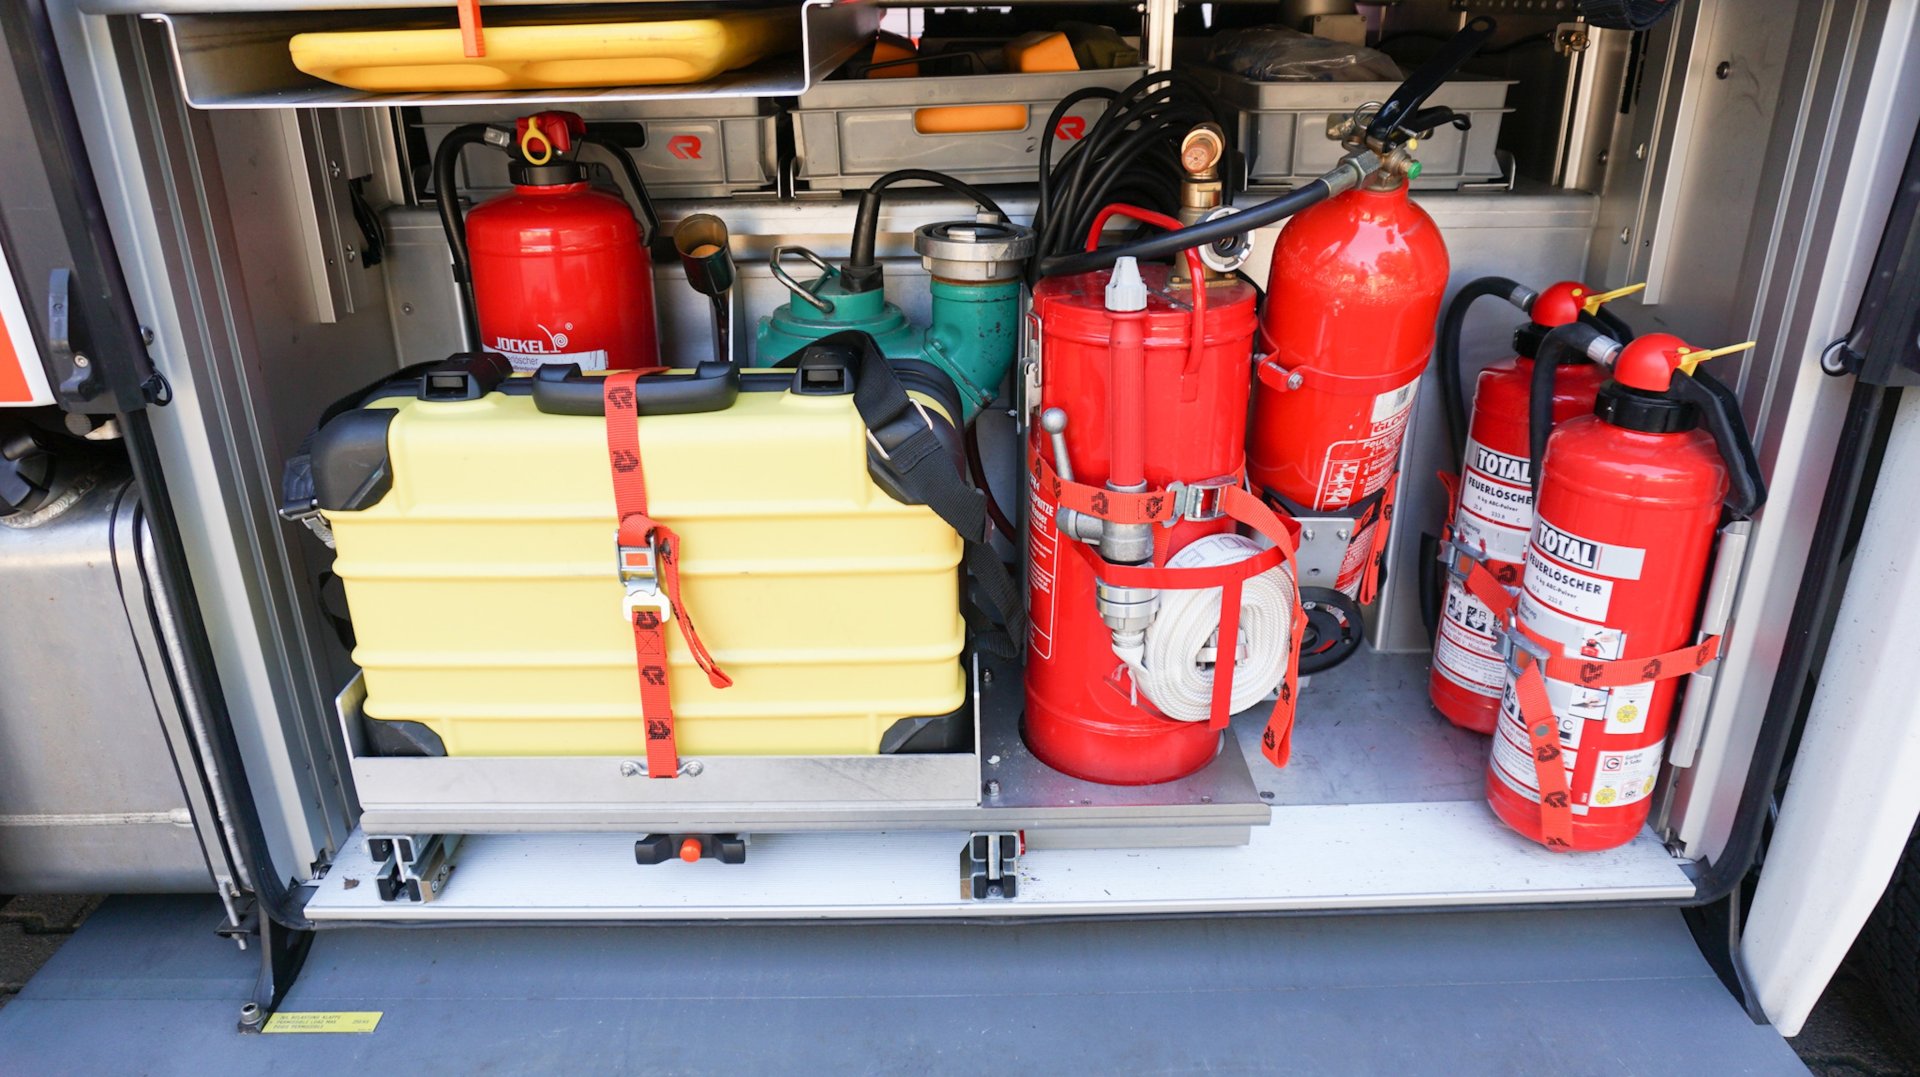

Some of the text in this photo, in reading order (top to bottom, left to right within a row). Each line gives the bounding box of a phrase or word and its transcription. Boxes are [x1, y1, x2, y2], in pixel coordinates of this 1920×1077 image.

[495, 336, 549, 354] JOCKEL
[1478, 449, 1532, 484] TOTAL
[1467, 476, 1533, 506] FEUERLÖSCHE
[1538, 522, 1594, 568] TOTAL
[1529, 552, 1603, 595] FEUERLÖSCHER
